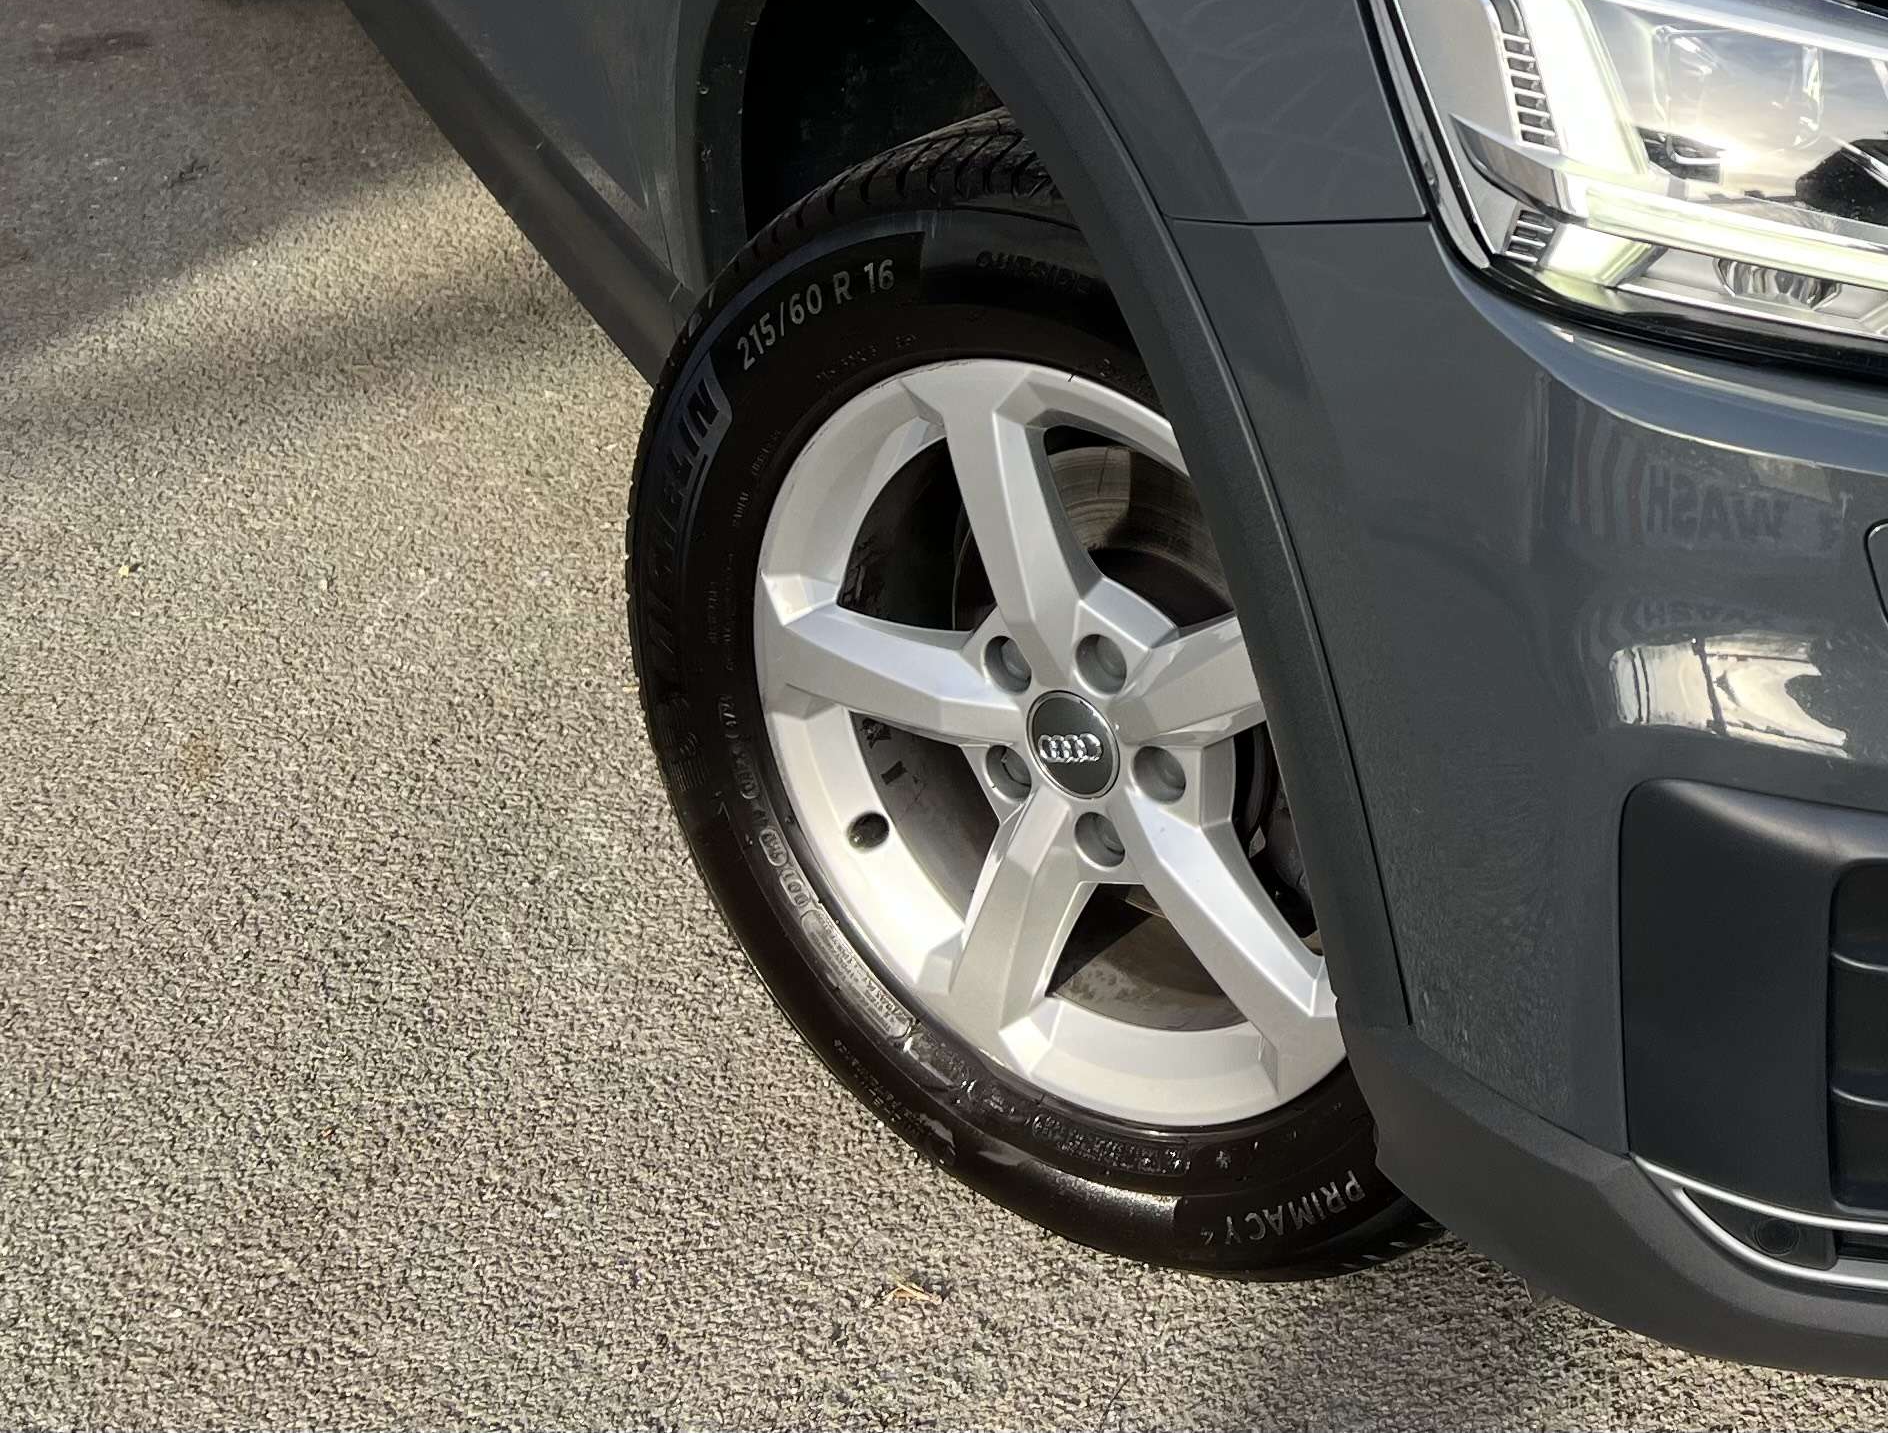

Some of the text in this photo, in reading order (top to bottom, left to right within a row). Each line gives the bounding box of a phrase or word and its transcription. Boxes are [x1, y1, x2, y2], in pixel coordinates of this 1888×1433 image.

[736, 282, 824, 372] 215/60
[832, 269, 855, 305] R
[862, 257, 896, 294] 16
[1222, 1168, 1366, 1246] PRIMACY
